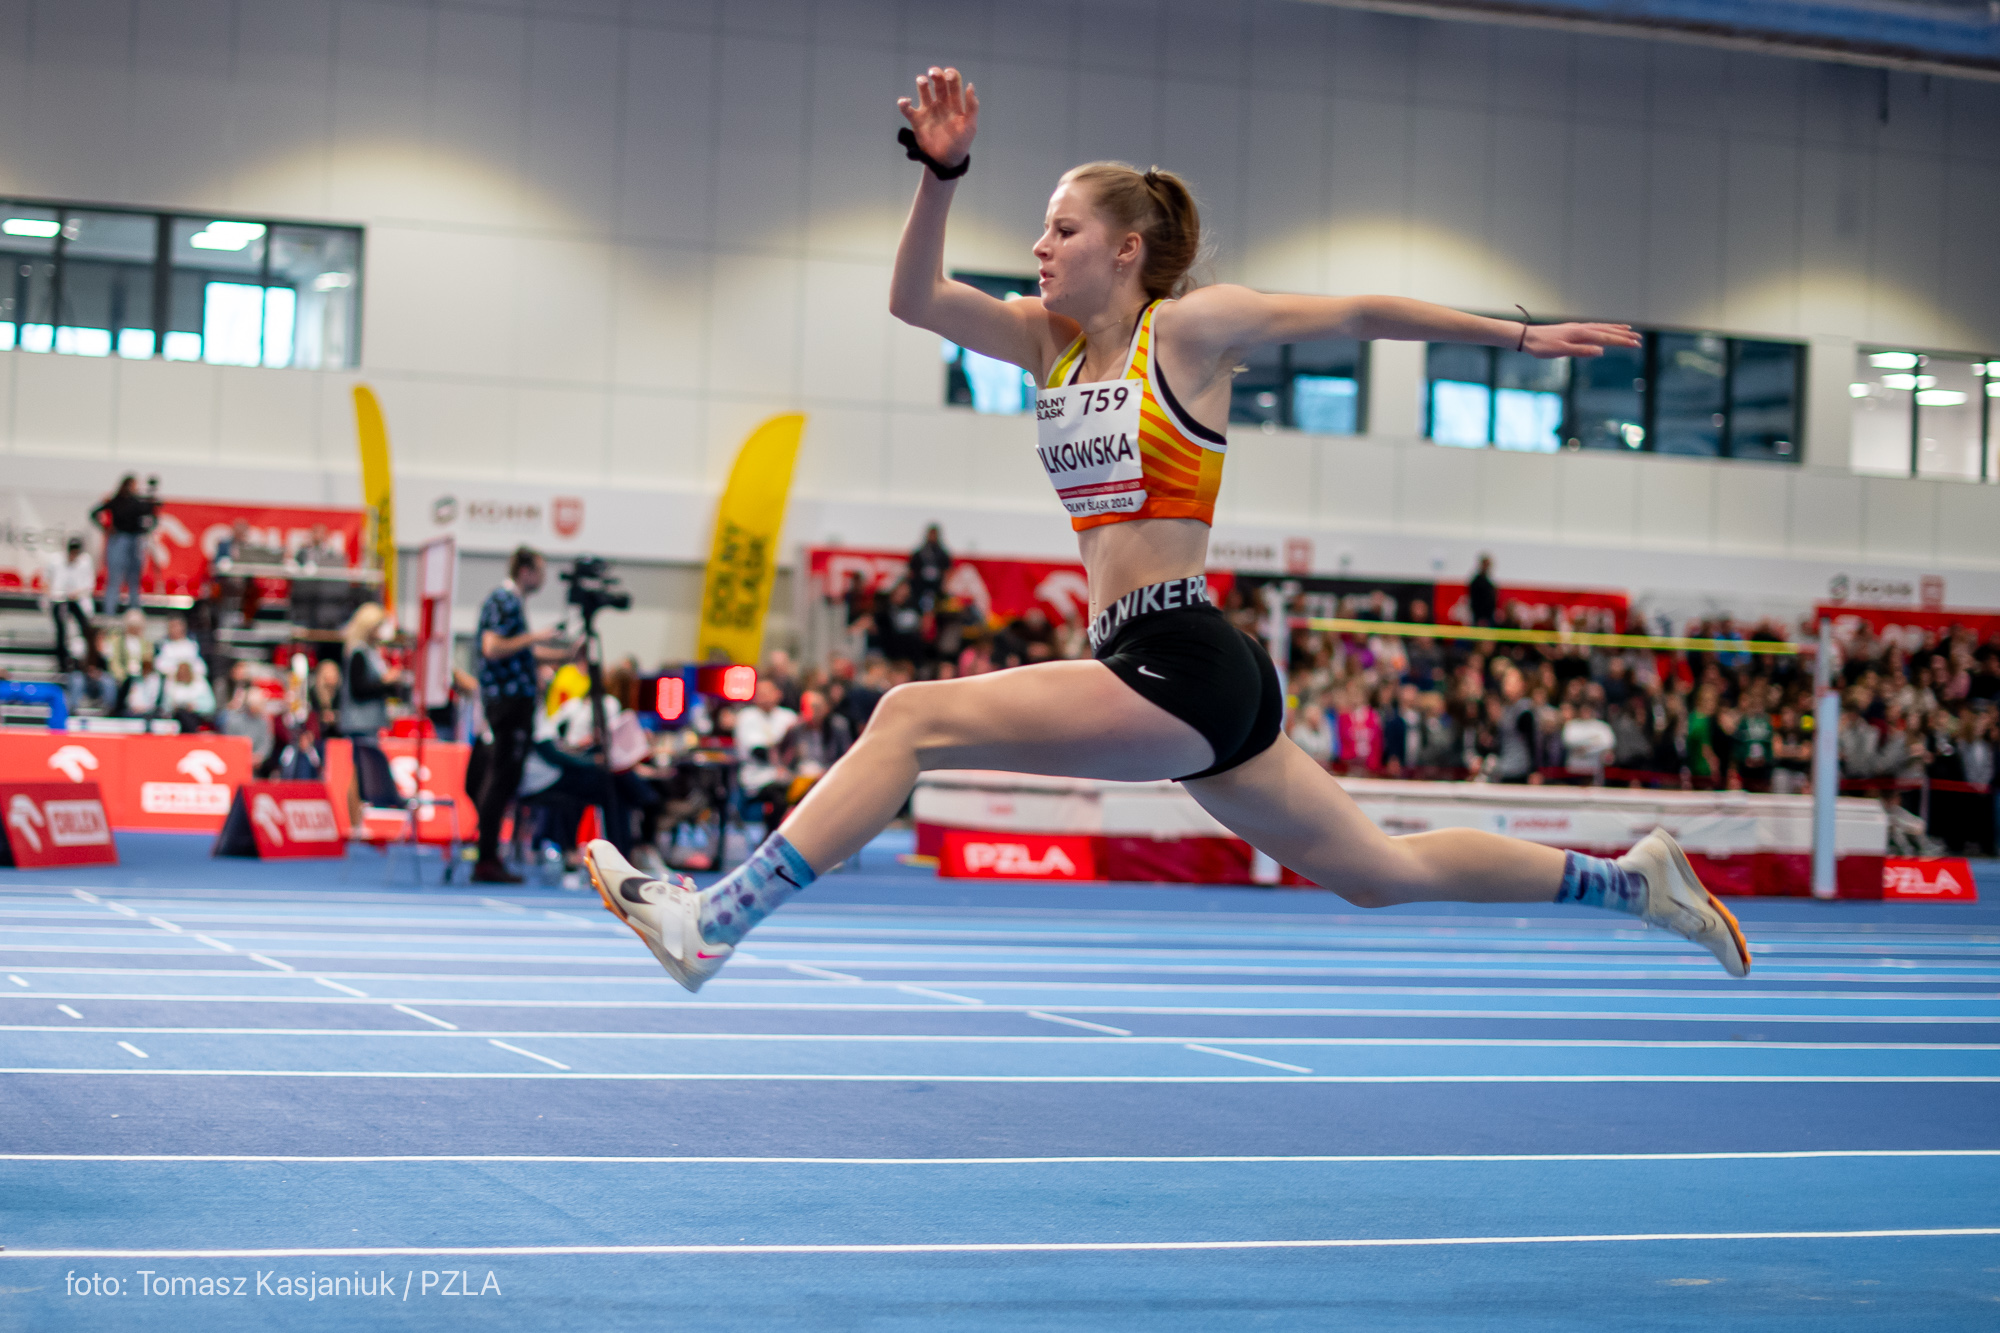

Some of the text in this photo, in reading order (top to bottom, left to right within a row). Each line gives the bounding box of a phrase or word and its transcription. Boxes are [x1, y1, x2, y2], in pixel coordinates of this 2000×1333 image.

[1080, 387, 1129, 416] 759
[1063, 497, 1134, 513] OLNY ŚLĄSK 2024
[1115, 579, 1182, 626] NIKE
[1186, 575, 1211, 605] PR
[963, 841, 1077, 876] PZLA
